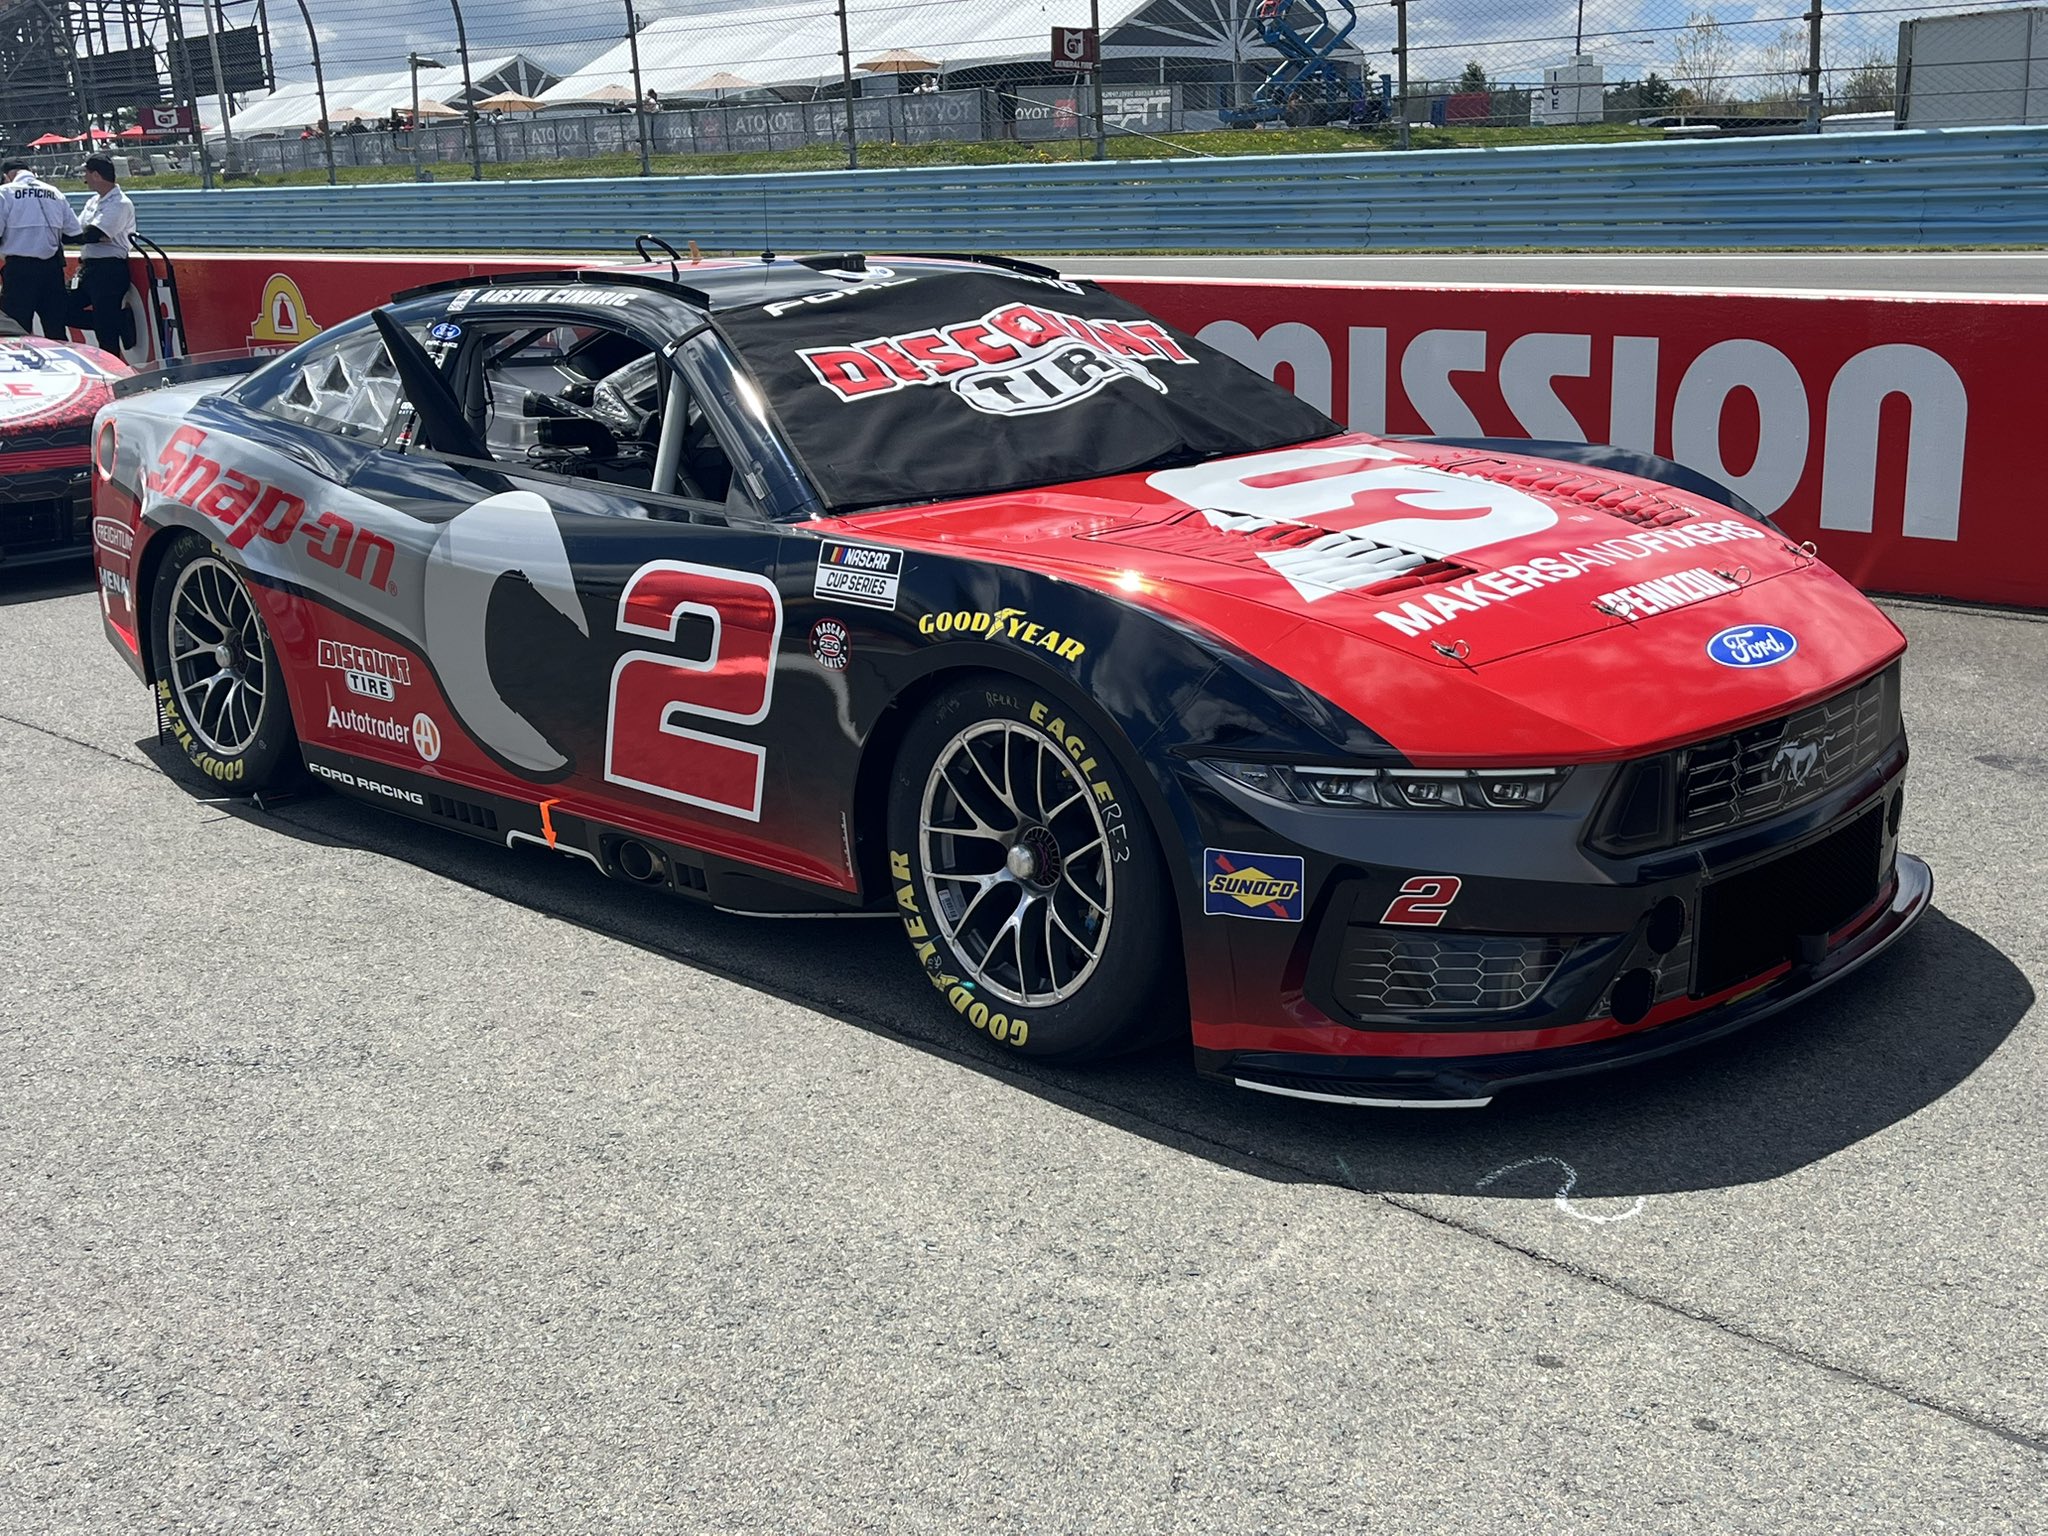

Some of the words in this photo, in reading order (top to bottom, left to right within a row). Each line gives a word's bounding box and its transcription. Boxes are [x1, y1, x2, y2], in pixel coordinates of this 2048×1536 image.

[1054, 60, 1080, 69] GENERAL
[1551, 70, 1560, 110] ICE
[14, 188, 57, 201] OFFICIAL
[475, 289, 552, 303] AUSTIN
[547, 289, 640, 307] CINDRIC
[795, 302, 1200, 403] DISCOUNT
[973, 346, 1115, 404] TIR
[843, 547, 891, 571] NASCAR
[826, 571, 849, 588] CUP
[849, 574, 887, 595] SERIES
[1598, 567, 1741, 621] PENNZOIL
[815, 622, 847, 642] NASCAR
[819, 640, 840, 651] 250
[1722, 630, 1787, 663] Ford
[318, 639, 412, 686] DISCOUNT
[814, 650, 848, 669] SALUTES
[349, 674, 390, 698] TIRE
[604, 559, 783, 823] 2
[327, 705, 410, 745] Autotrader
[1029, 700, 1115, 804] EAGLE
[309, 763, 355, 786] FORD
[357, 777, 424, 806] RACING
[1212, 876, 1295, 899] SUNOCO
[1379, 875, 1463, 927] 2
